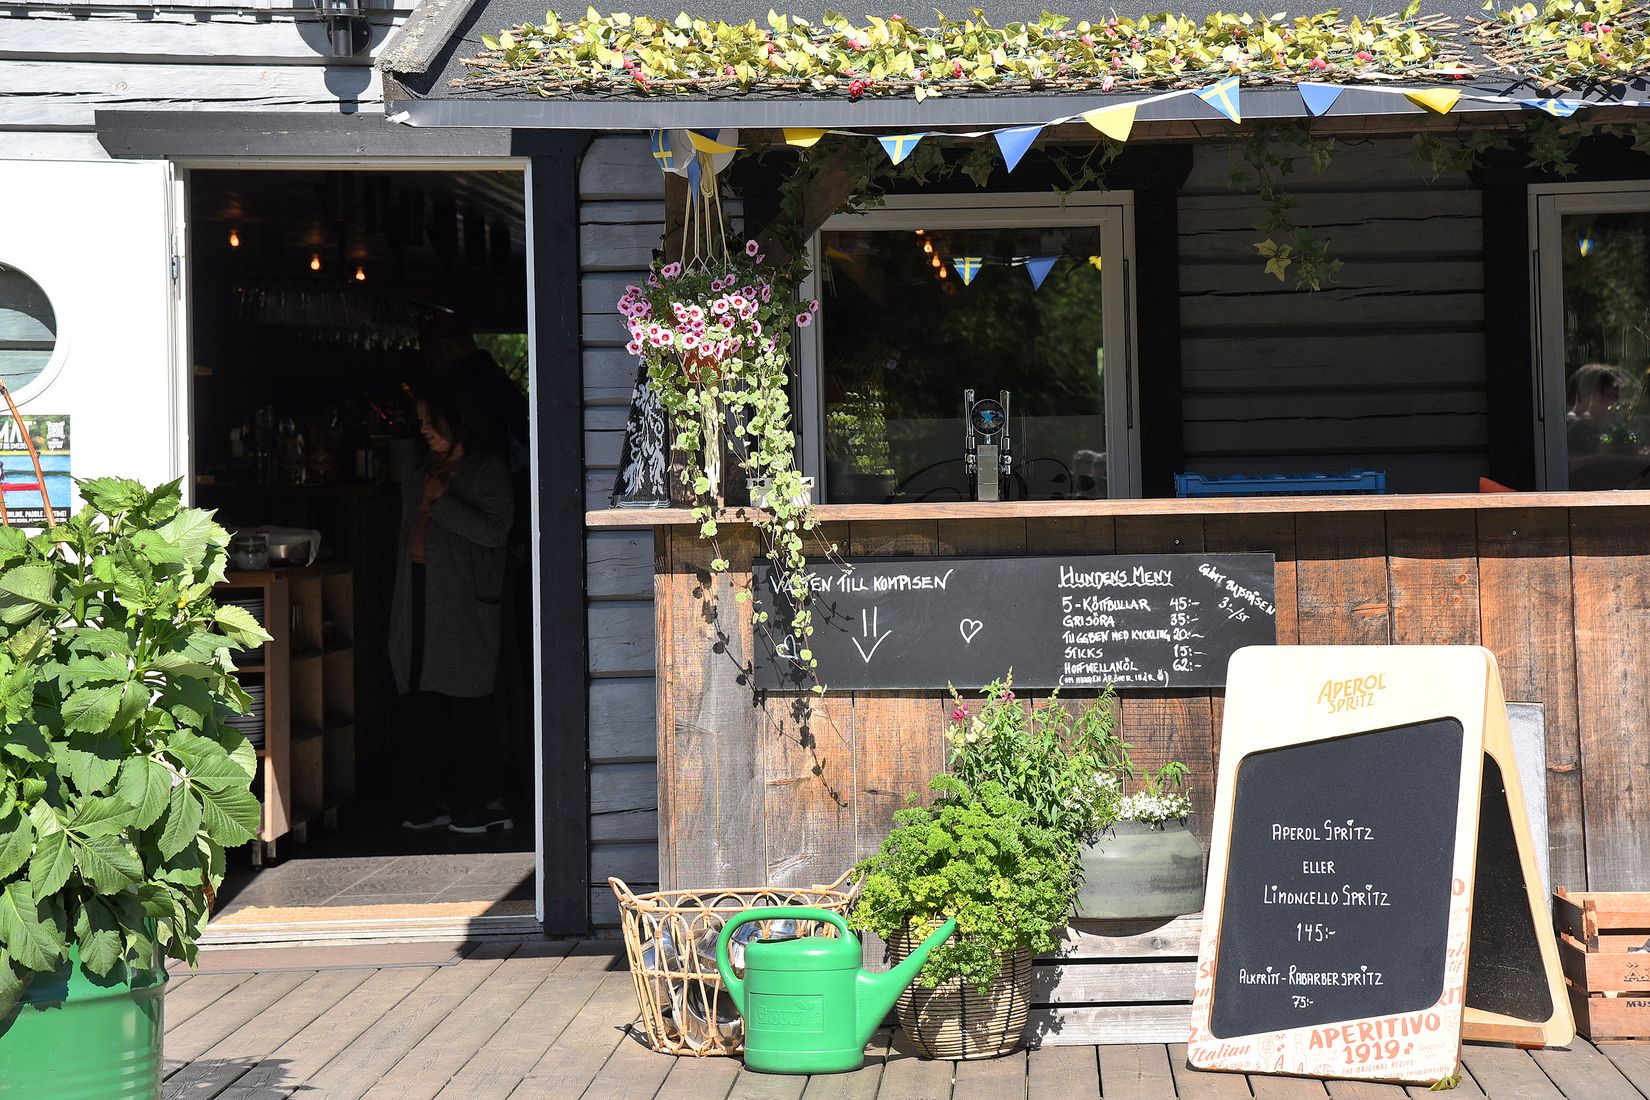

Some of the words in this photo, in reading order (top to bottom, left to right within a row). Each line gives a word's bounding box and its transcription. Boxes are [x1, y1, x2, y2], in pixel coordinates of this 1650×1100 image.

[836, 573, 869, 593] TILL
[873, 568, 954, 591] KOMPISEN
[1060, 565, 1128, 586] HUNDENS
[1132, 565, 1173, 585] MENY
[1062, 612, 1116, 628] GRISÖRA
[1111, 629, 1129, 643] MED
[1064, 646, 1104, 659] STICKS
[1317, 672, 1386, 705] APEROL
[1272, 823, 1321, 841] APEROL
[1303, 860, 1336, 874] ELLER
[1291, 995, 1315, 1009] 75:-
[1309, 1012, 1441, 1050] APERITIVO
[1191, 1042, 1251, 1064] Italian
[1343, 1039, 1400, 1065] 1919
